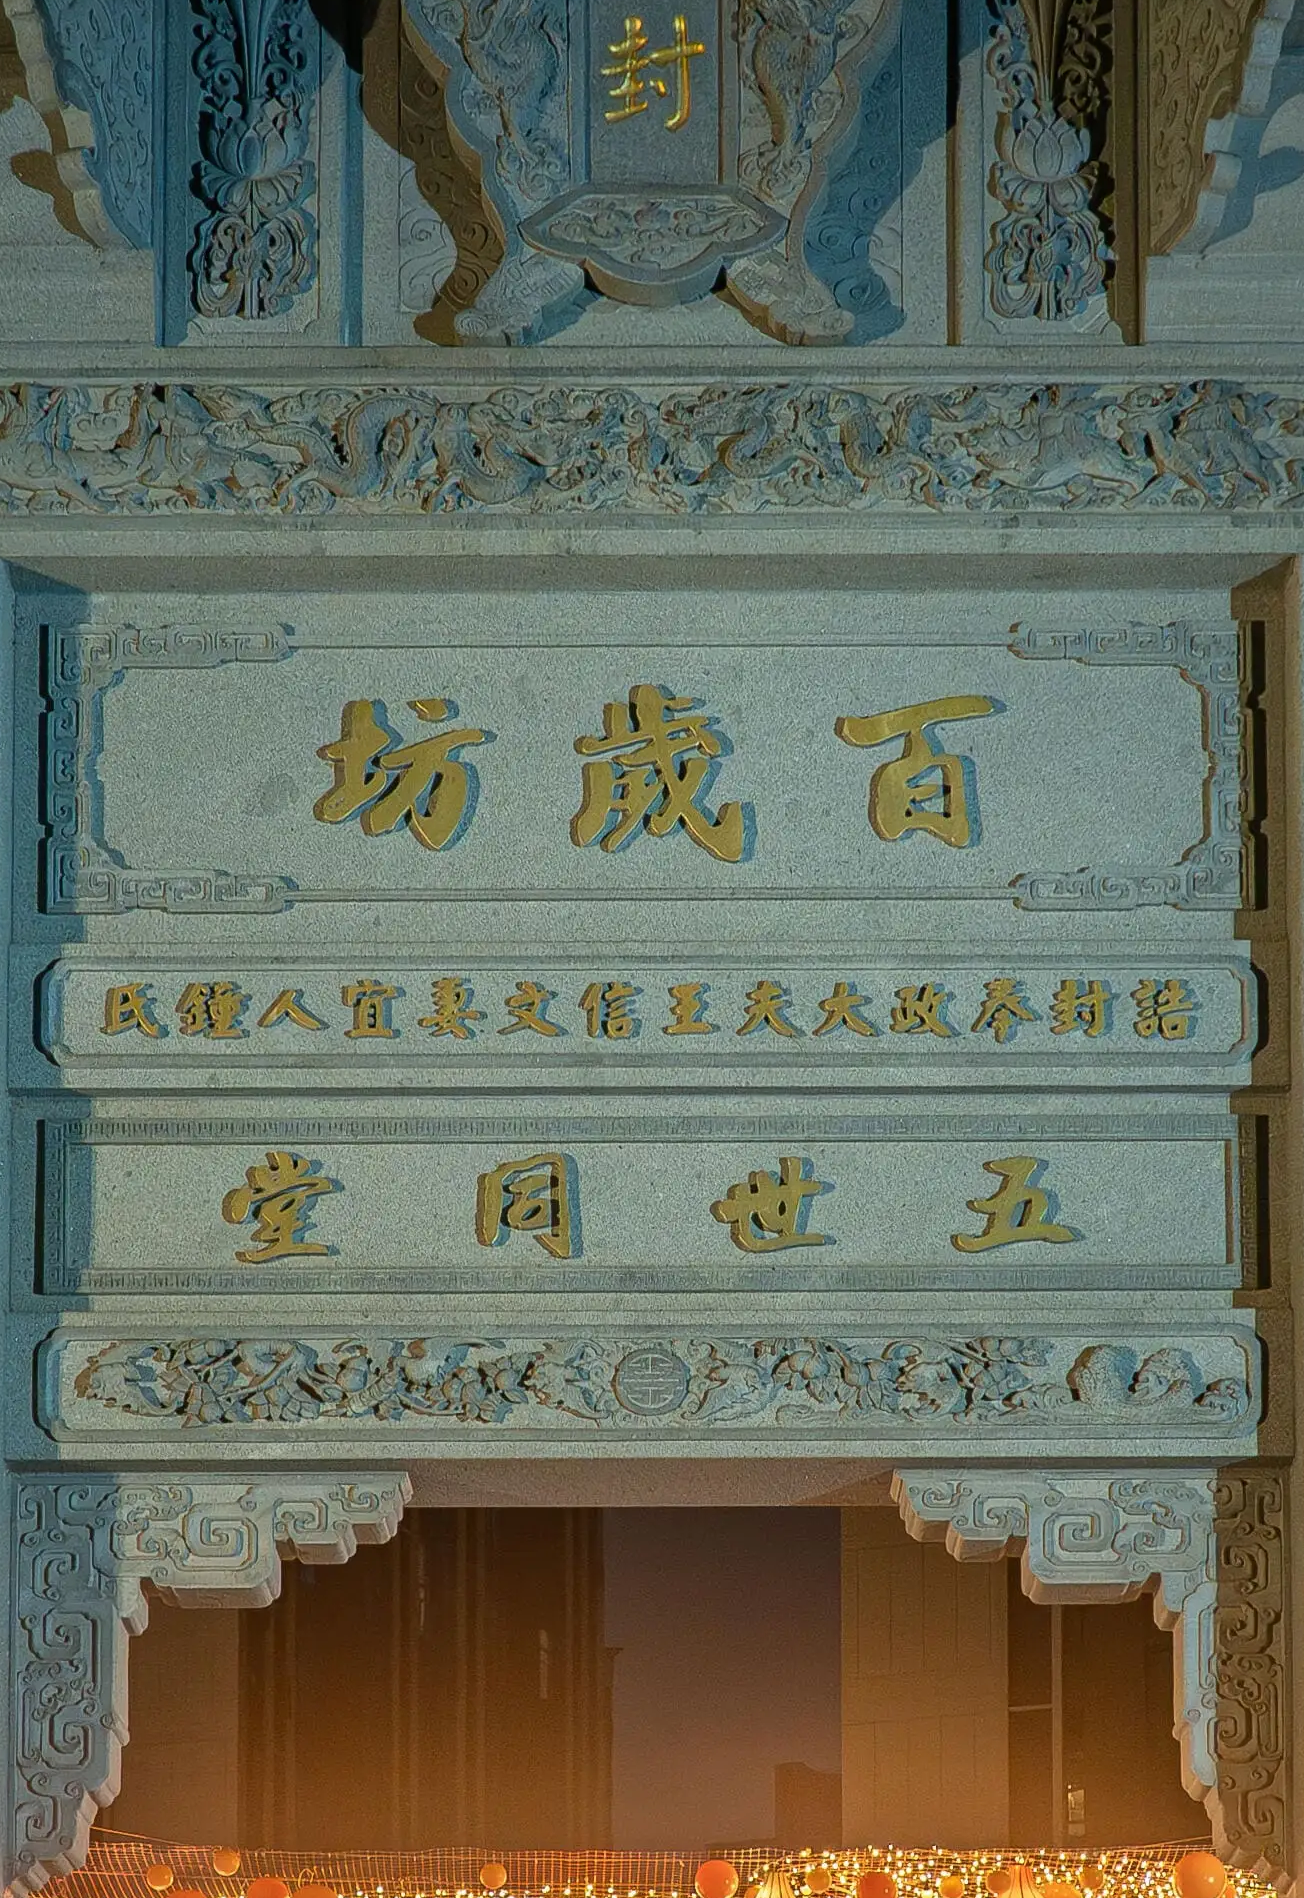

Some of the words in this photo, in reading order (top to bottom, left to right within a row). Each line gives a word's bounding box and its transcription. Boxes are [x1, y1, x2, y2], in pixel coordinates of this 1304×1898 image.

[313, 684, 996, 863] 百歲坊
[219, 1151, 1076, 1266] 五世同堂
